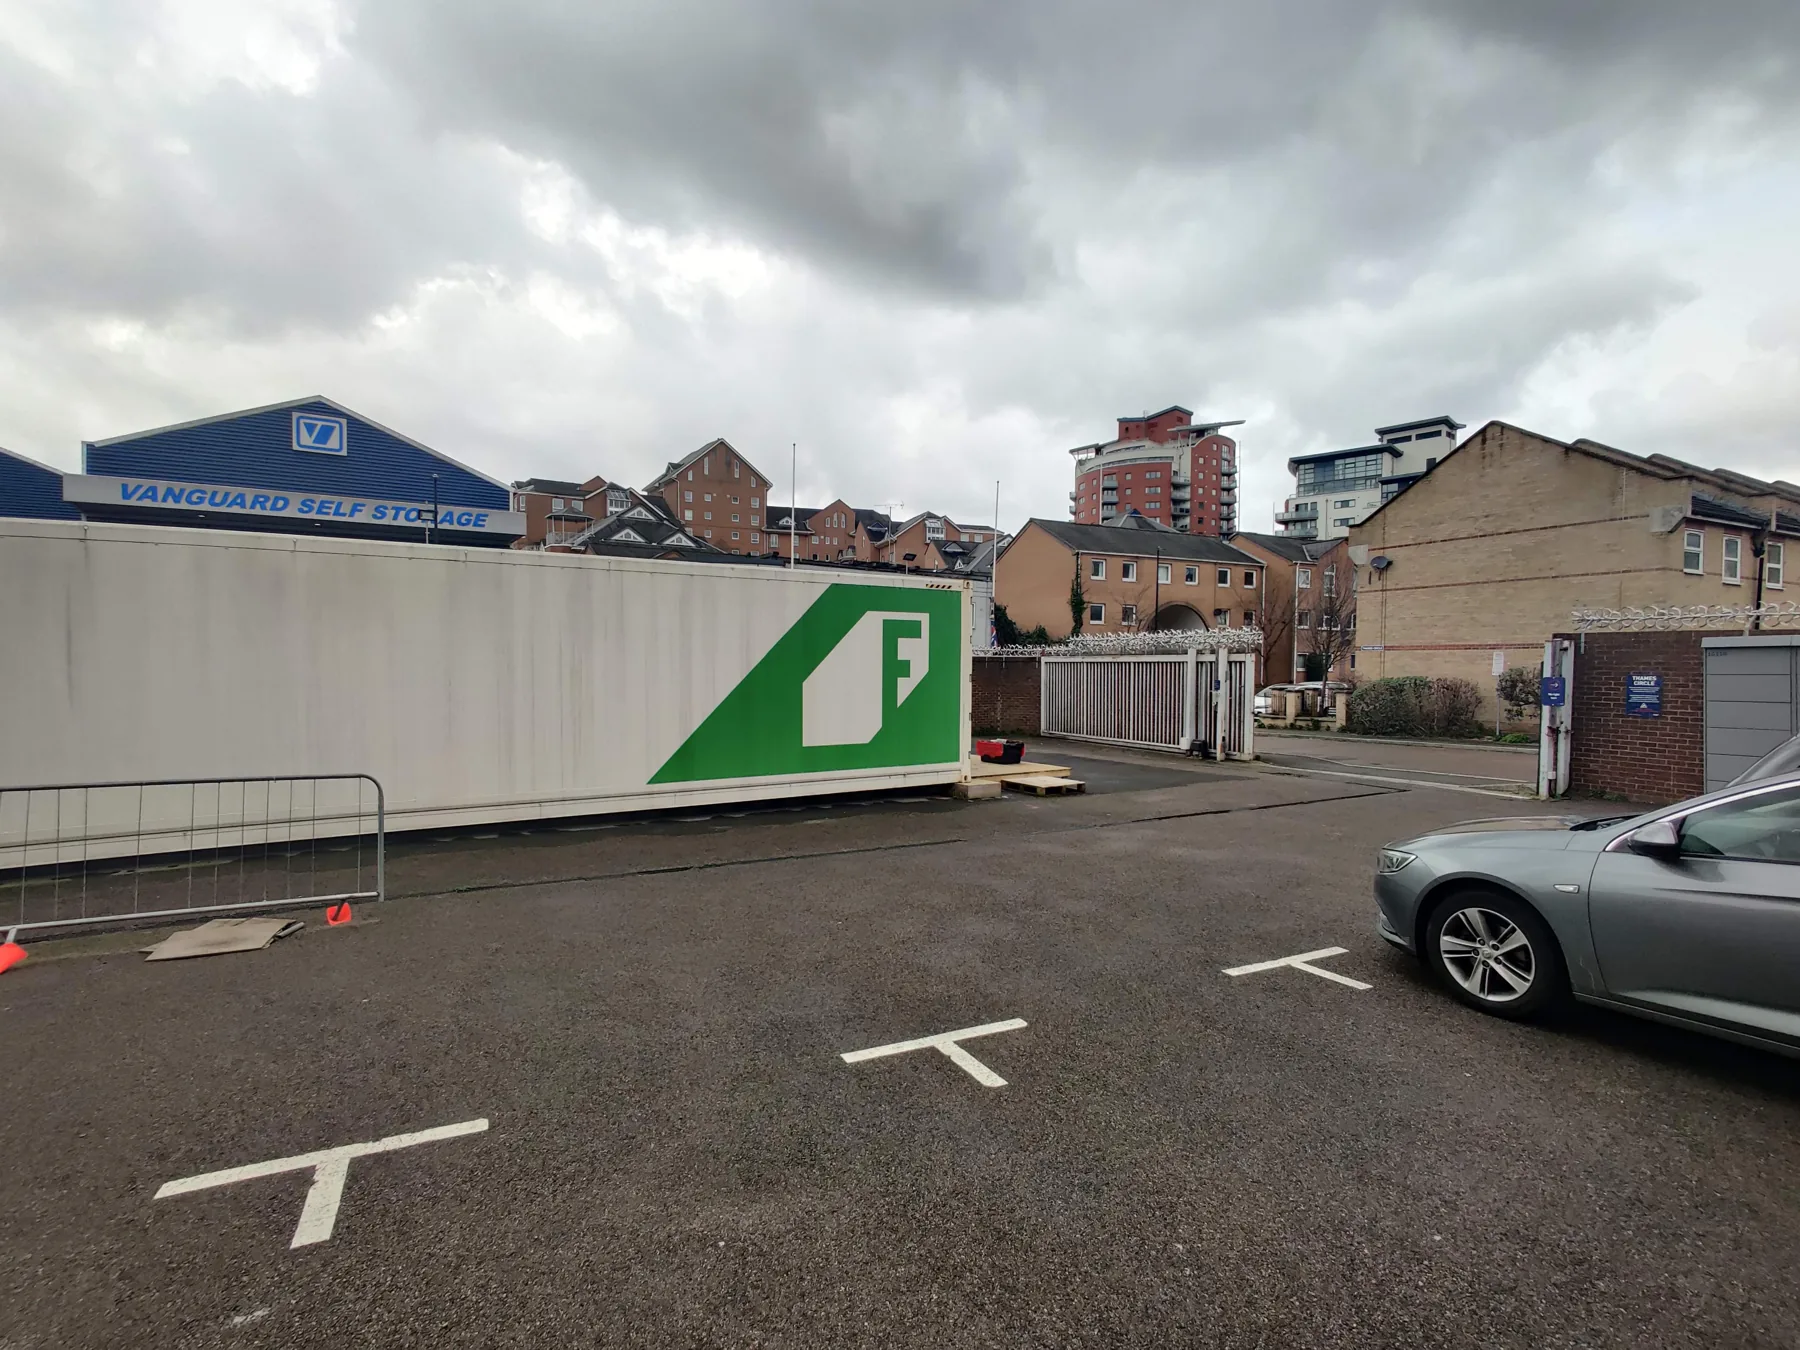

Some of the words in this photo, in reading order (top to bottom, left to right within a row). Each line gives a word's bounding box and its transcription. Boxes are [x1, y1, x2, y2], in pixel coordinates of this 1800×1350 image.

[121, 483, 290, 513] VANGUARD
[297, 498, 367, 518] SELF
[371, 504, 490, 528] STOAGE
